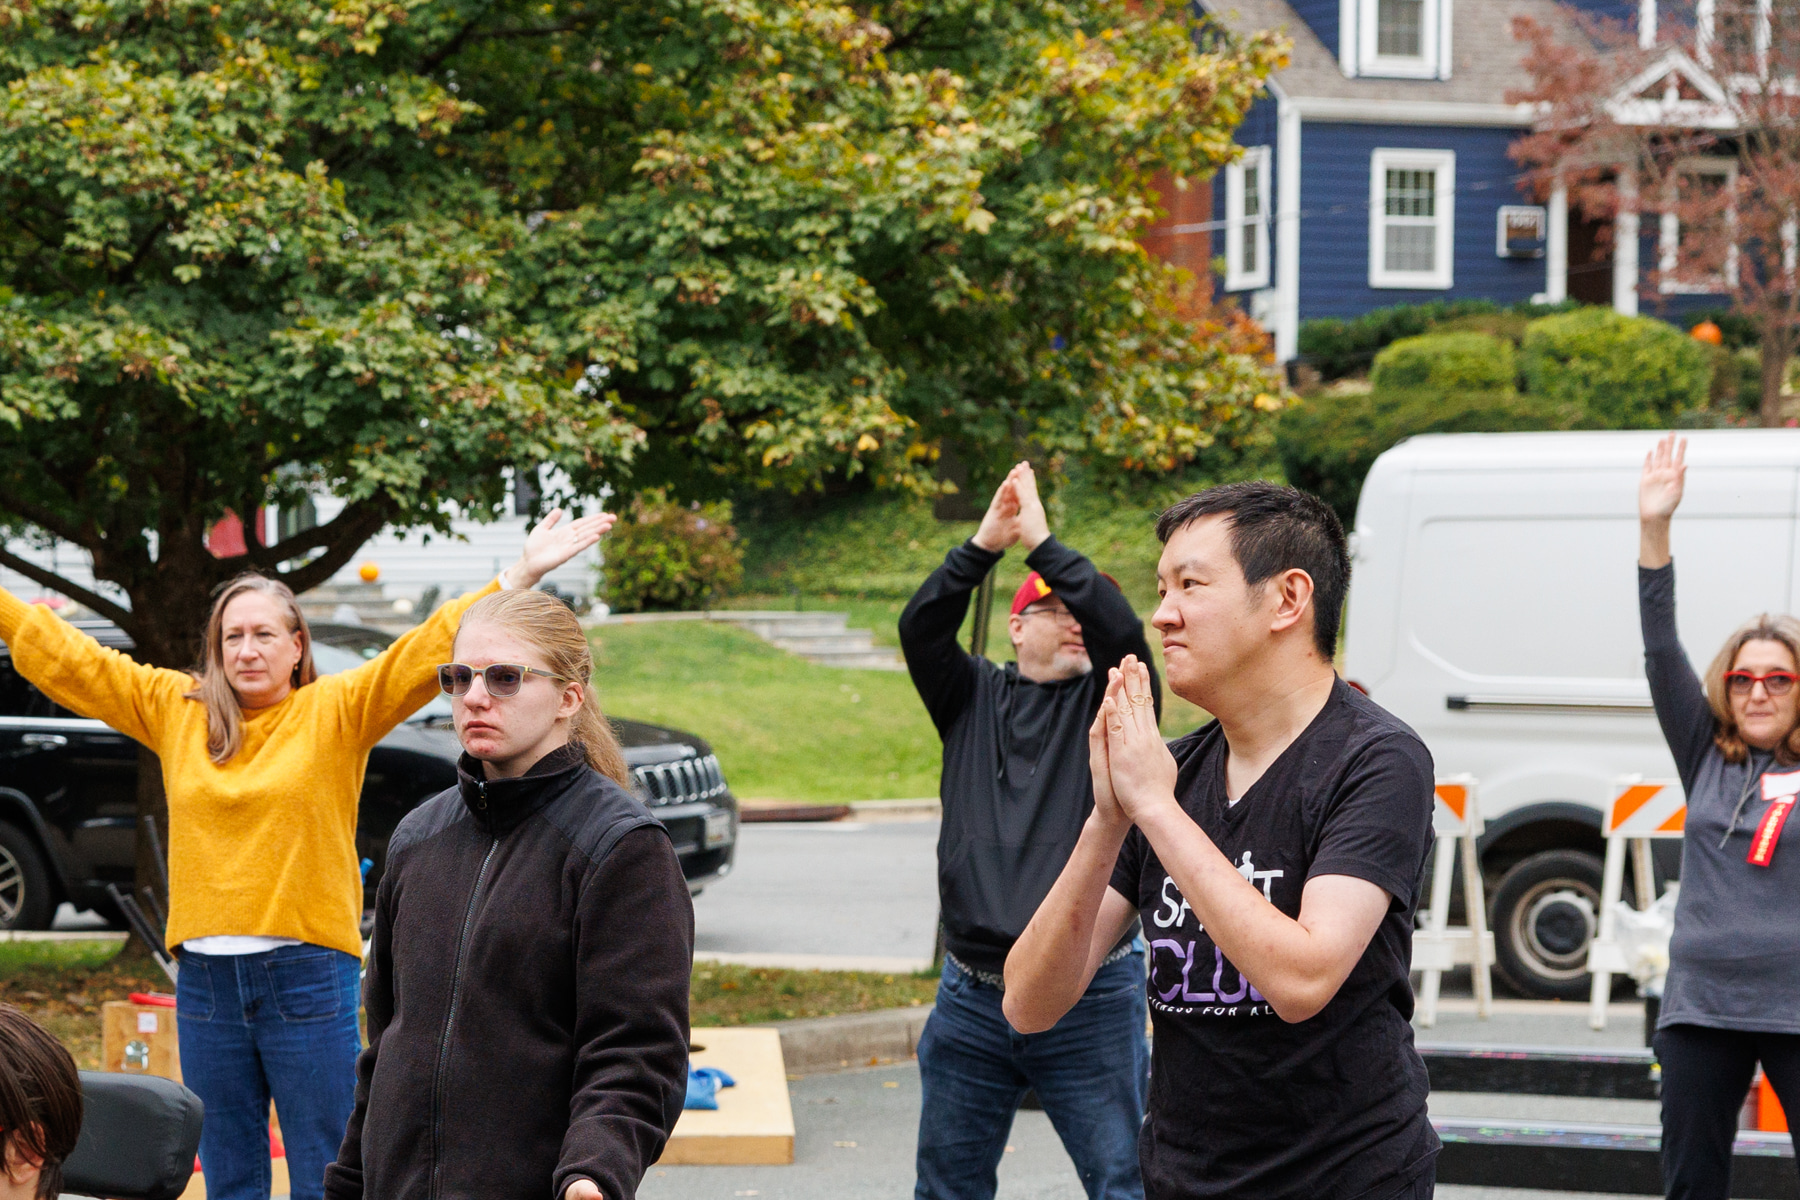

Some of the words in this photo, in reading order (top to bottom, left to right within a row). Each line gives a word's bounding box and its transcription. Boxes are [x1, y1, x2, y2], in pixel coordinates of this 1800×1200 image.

[1150, 939, 1266, 1004] CLU
[1202, 1006, 1238, 1017] FOR
[1250, 1005, 1276, 1017] AL
